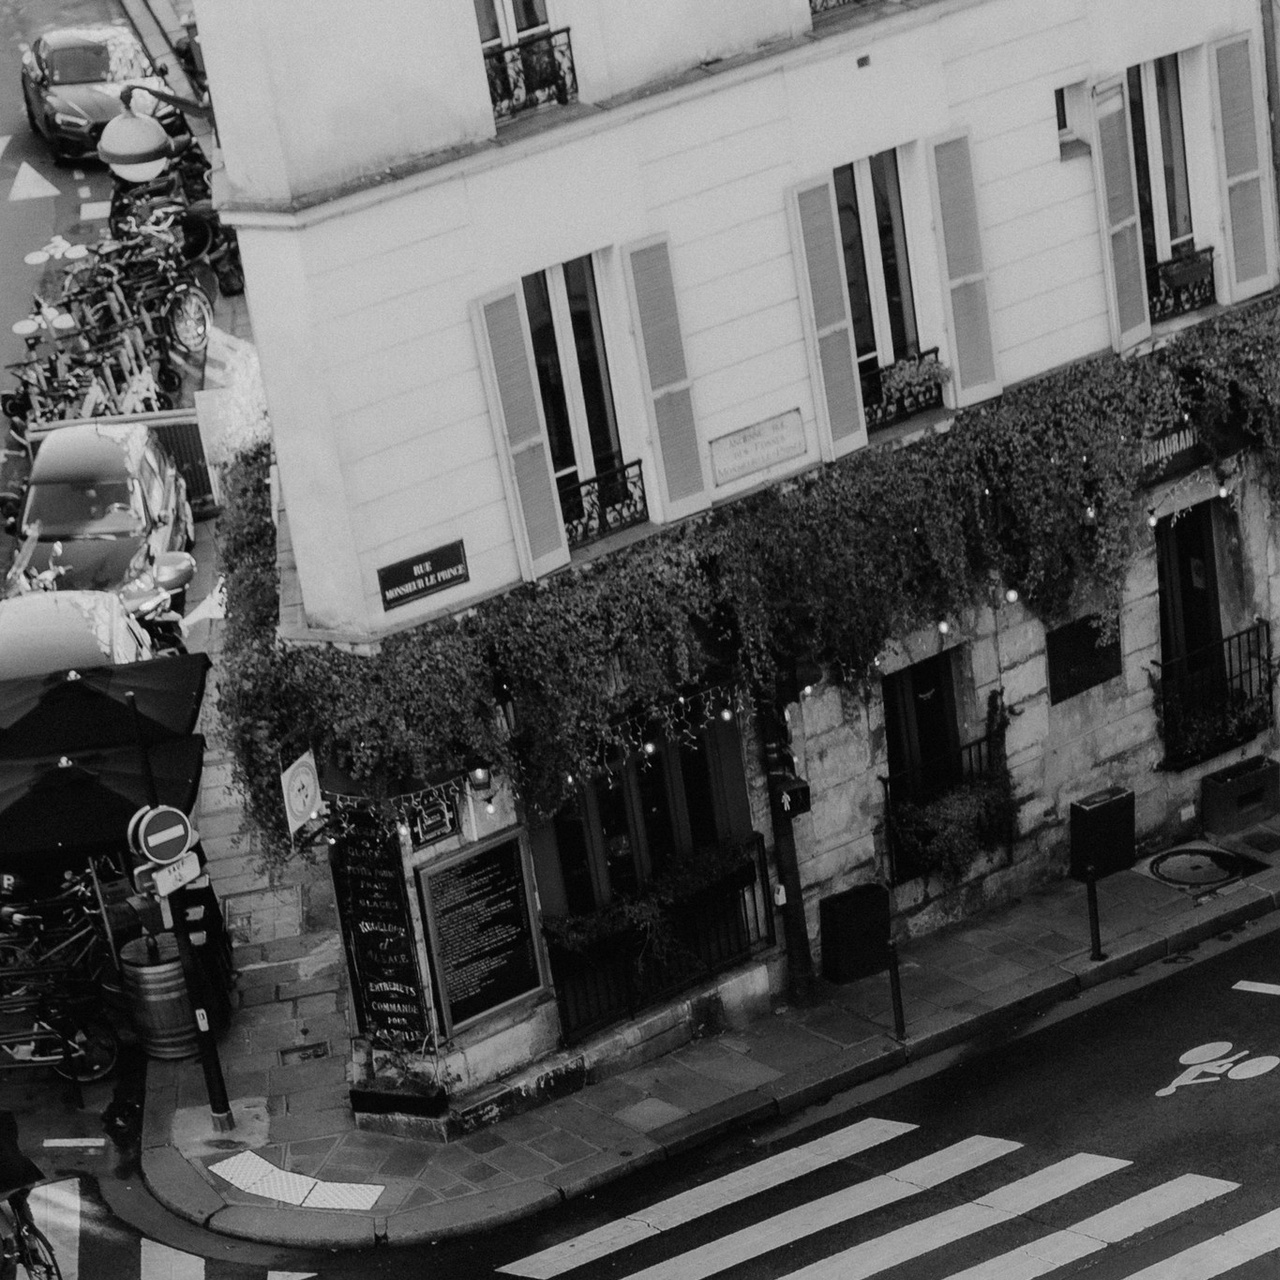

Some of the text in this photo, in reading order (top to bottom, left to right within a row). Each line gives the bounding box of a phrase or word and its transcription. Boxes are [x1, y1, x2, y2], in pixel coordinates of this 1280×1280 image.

[1139, 426, 1198, 468] ESTAURANT
[384, 563, 466, 601] MONSIEUR LE PRINCE
[412, 560, 433, 577] RUE
[371, 1000, 419, 1014] COMMANDE
